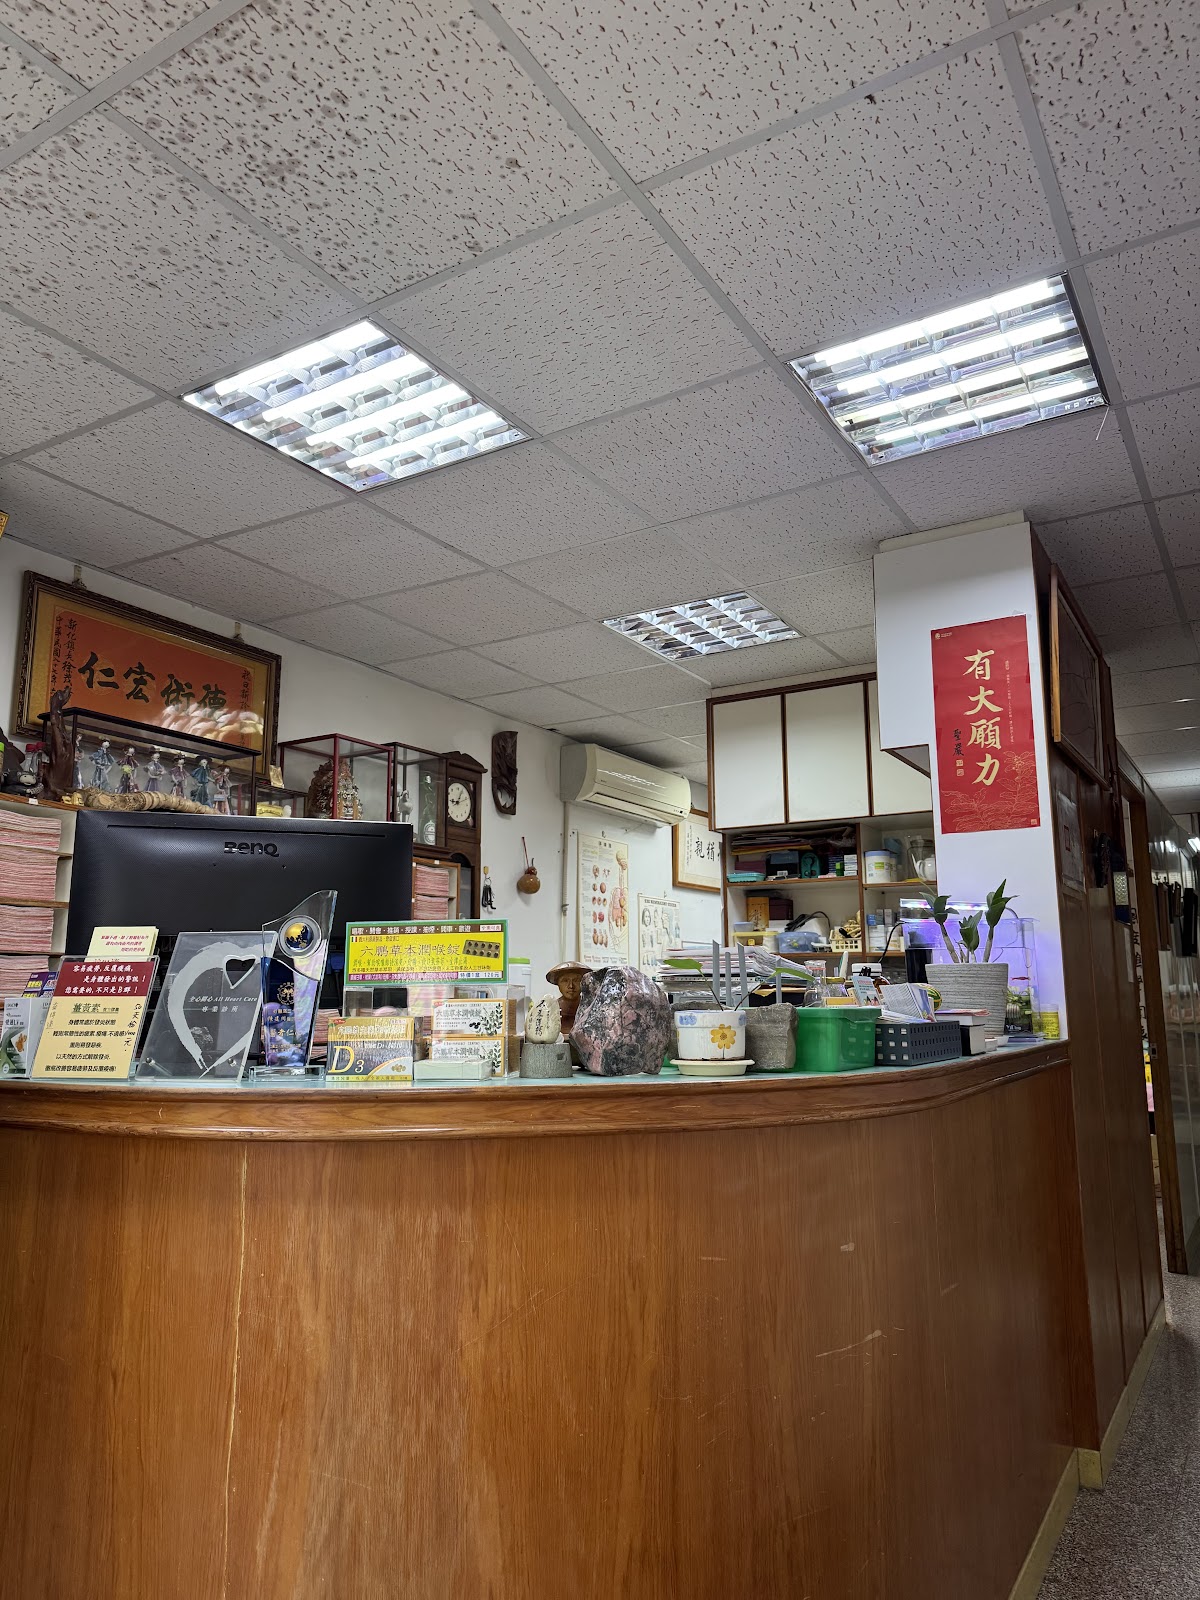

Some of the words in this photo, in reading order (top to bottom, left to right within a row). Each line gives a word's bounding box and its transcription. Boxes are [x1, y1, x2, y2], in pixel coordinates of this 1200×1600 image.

[962, 648, 1003, 786] 有大願力
[223, 841, 280, 857] BenQ
[360, 943, 460, 958] 六鵬草本潤喉錠
